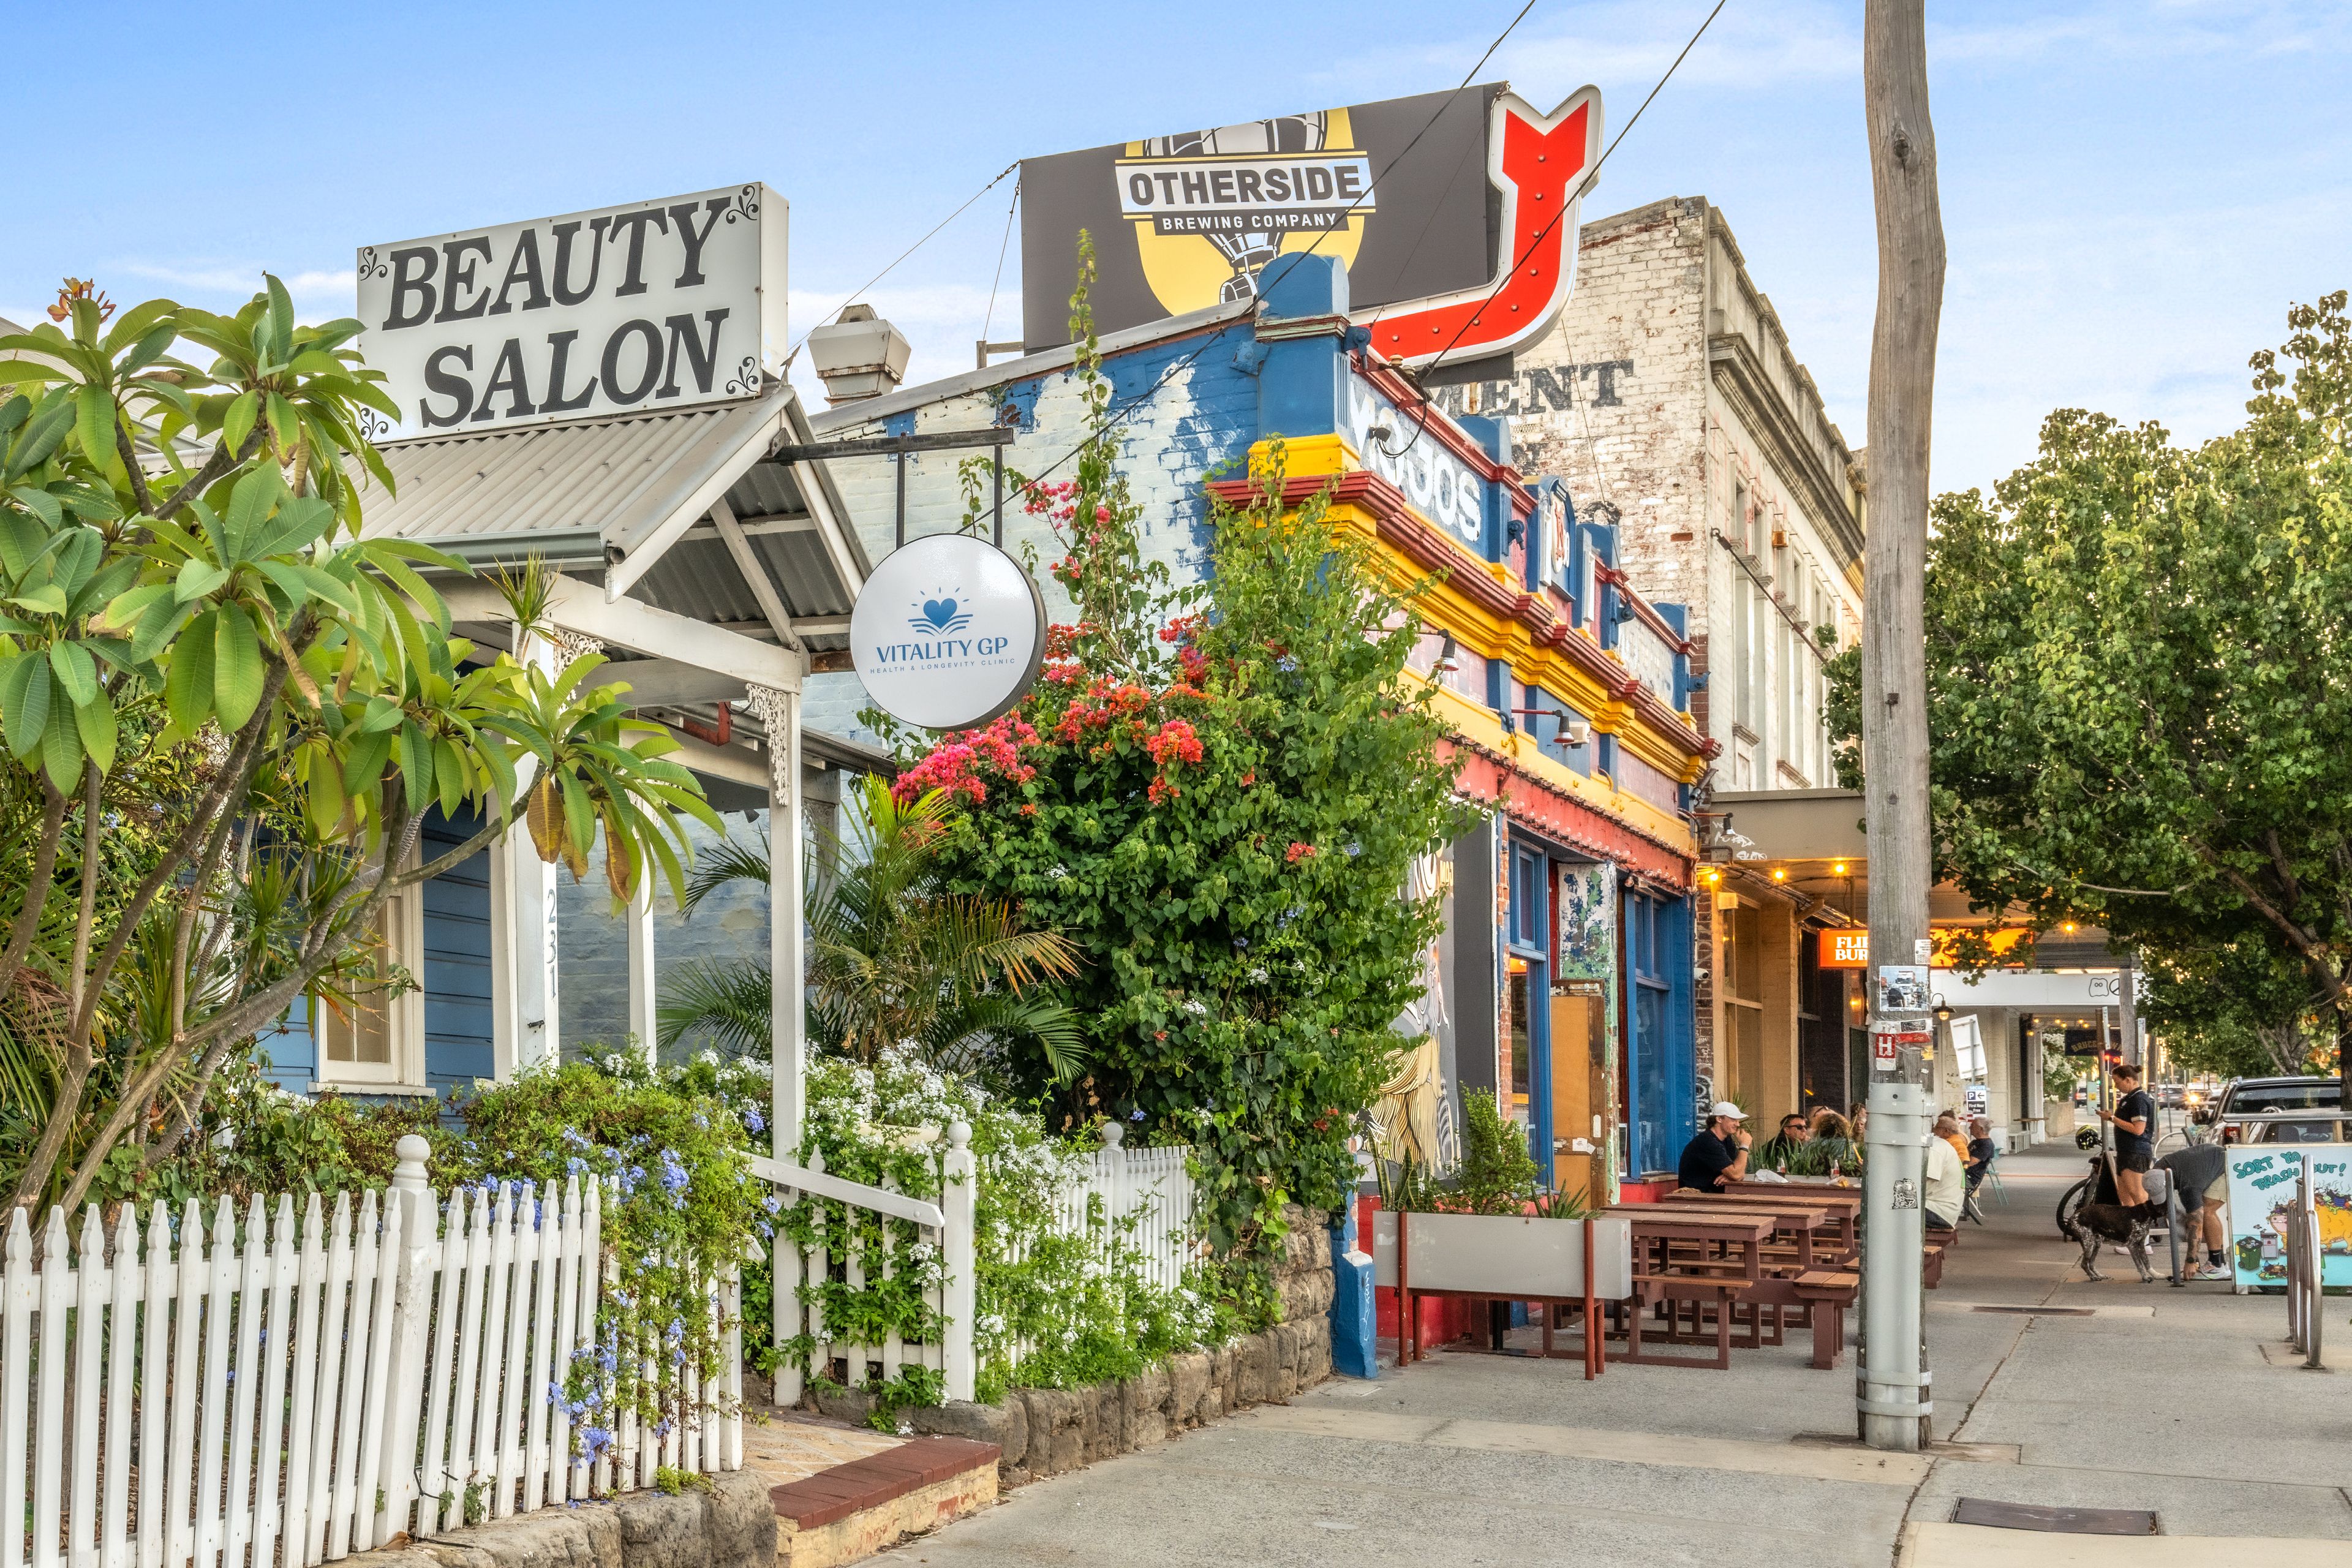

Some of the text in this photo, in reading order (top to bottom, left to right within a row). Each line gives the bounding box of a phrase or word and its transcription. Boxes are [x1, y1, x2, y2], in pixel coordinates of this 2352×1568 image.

[1129, 165, 1363, 206] OTHERSIDE
[1163, 213, 1336, 230] BREWING COMPANY
[382, 196, 731, 331] BEAUTY
[420, 307, 730, 428] SALON
[1350, 381, 1482, 542] MOJOS
[876, 637, 1008, 663] VITALITY GP
[921, 661, 975, 669] LONGEVITY
[546, 888, 556, 1000] 231
[2233, 1152, 2301, 1179] SORT YA
[2252, 1167, 2299, 1190] TRASH
